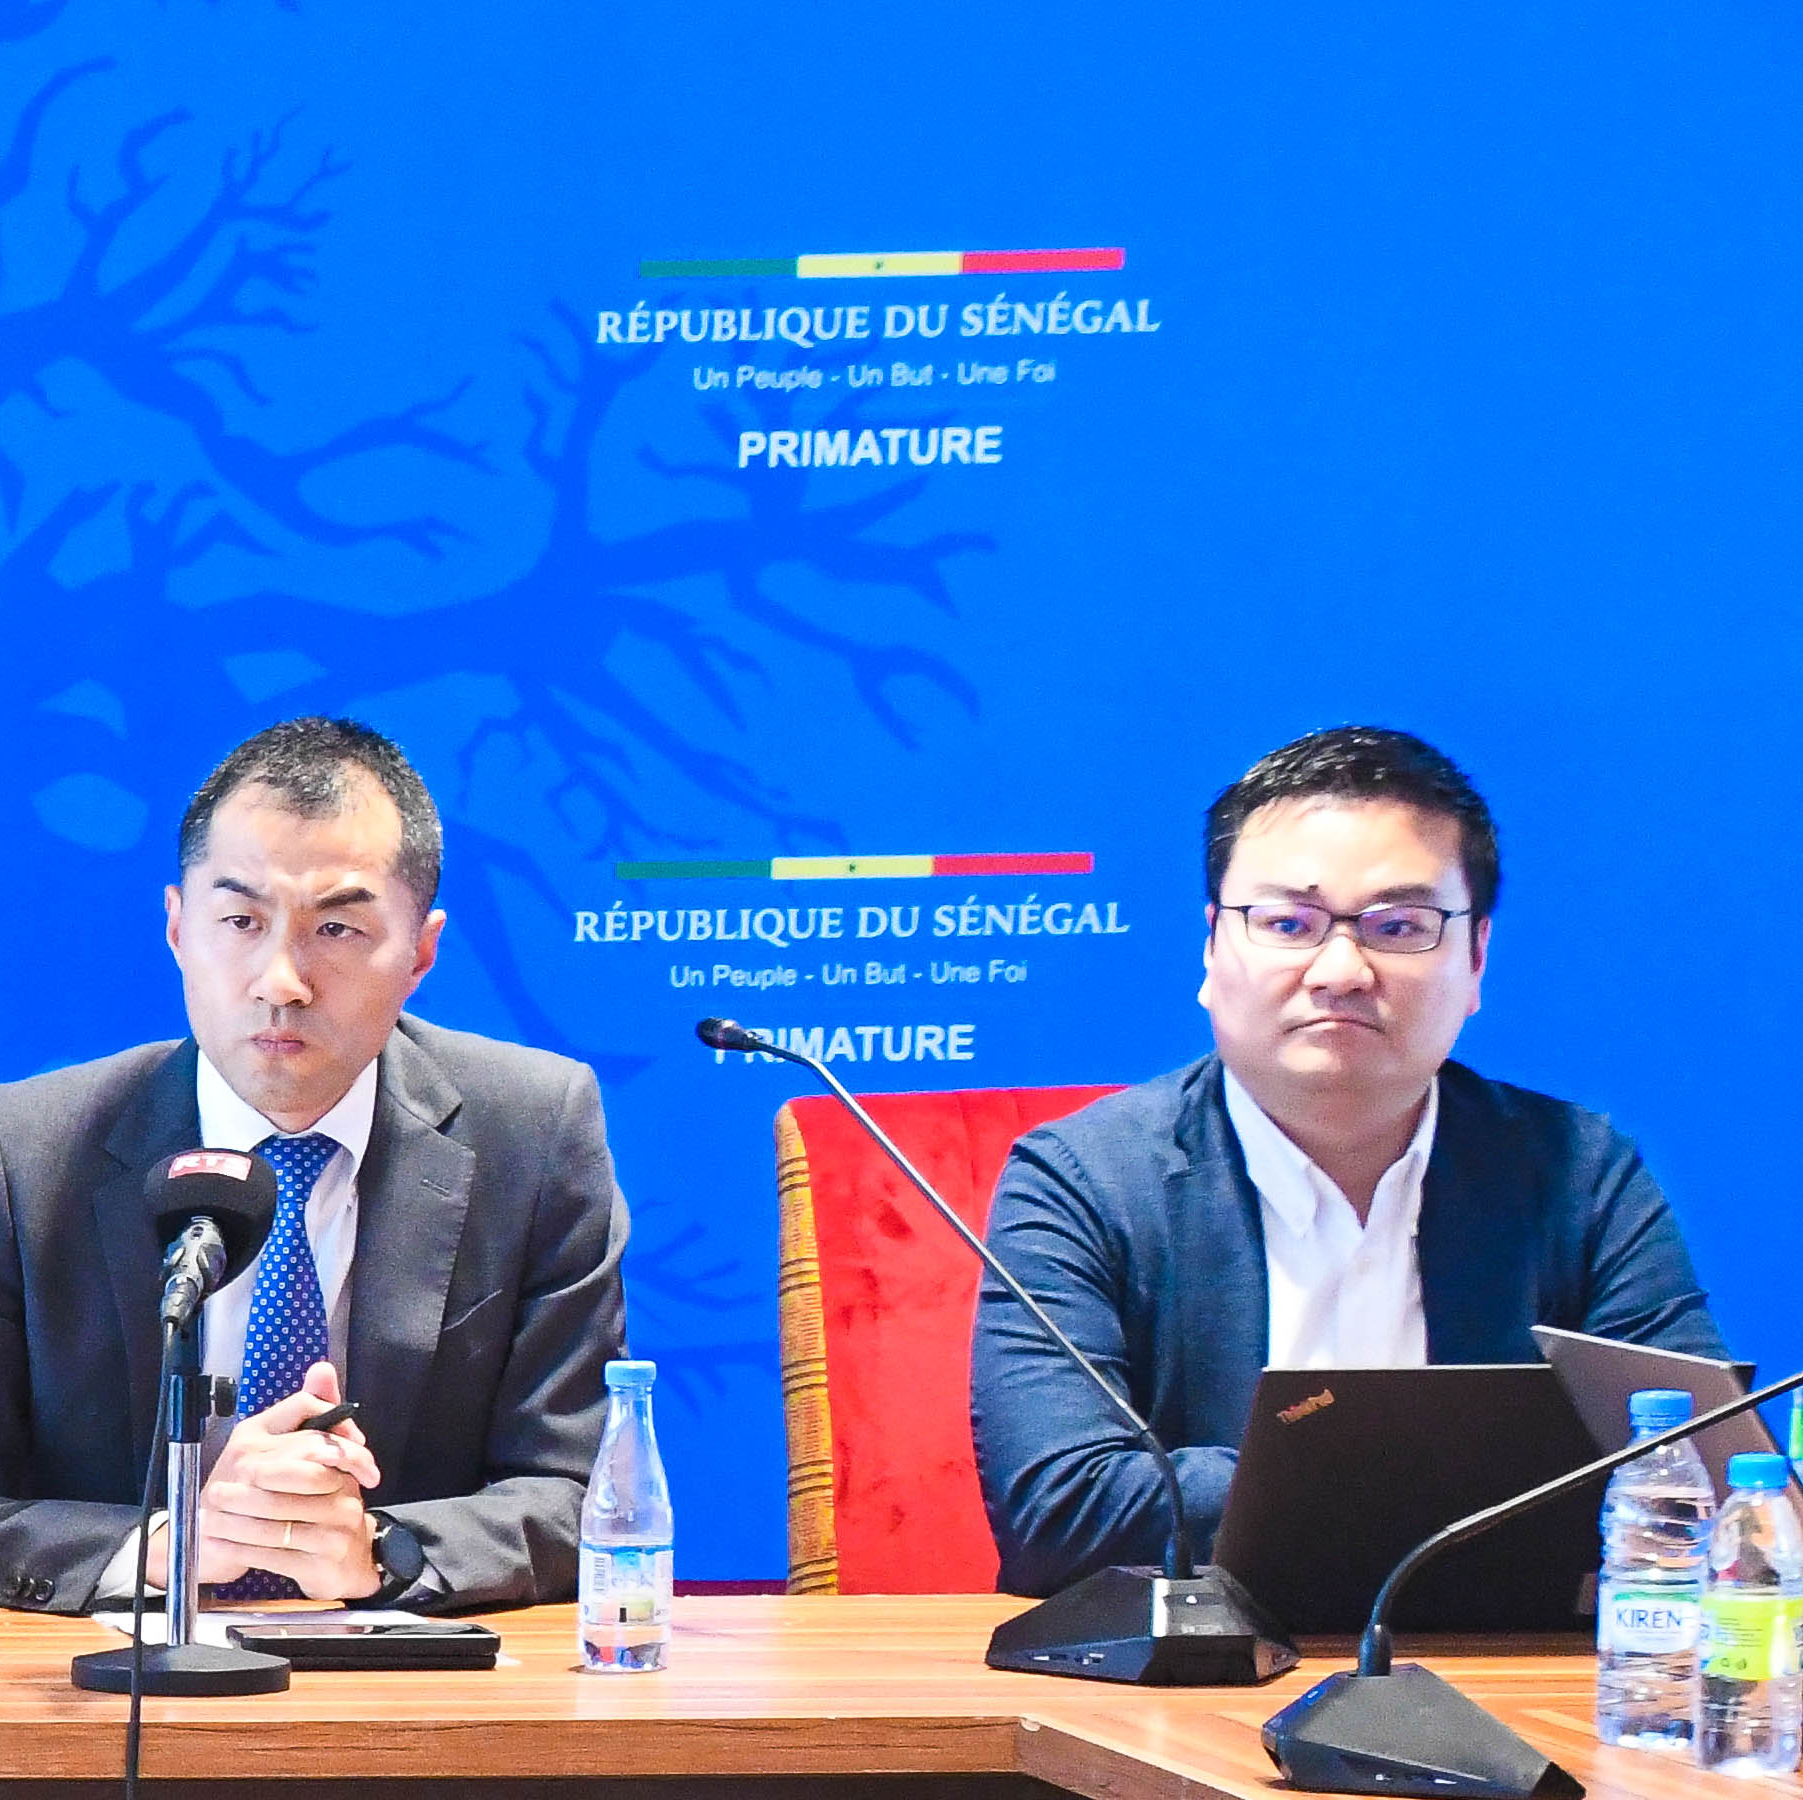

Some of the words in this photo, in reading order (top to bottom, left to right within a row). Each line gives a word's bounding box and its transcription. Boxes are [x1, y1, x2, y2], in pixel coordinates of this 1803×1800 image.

[598, 301, 869, 348] RÉPUBLIQUE
[885, 304, 948, 338] DU
[961, 292, 1159, 336] SÉNÉGAL
[694, 368, 729, 390] Un
[737, 366, 822, 392] Peuple
[848, 365, 883, 387] Un
[891, 362, 933, 386] But
[958, 363, 1008, 384] Une
[1017, 359, 1055, 382] Foi
[739, 426, 1002, 467] PRIMATURE
[575, 901, 843, 947] RÉPUBLIQUE
[857, 907, 919, 937] DU
[934, 894, 1129, 936] SÉNÉGAL
[671, 966, 704, 987] Un
[713, 965, 797, 990] Peuple
[823, 964, 857, 984] Un
[865, 962, 905, 984] But
[931, 962, 980, 984] Une
[989, 960, 1027, 982] Foi
